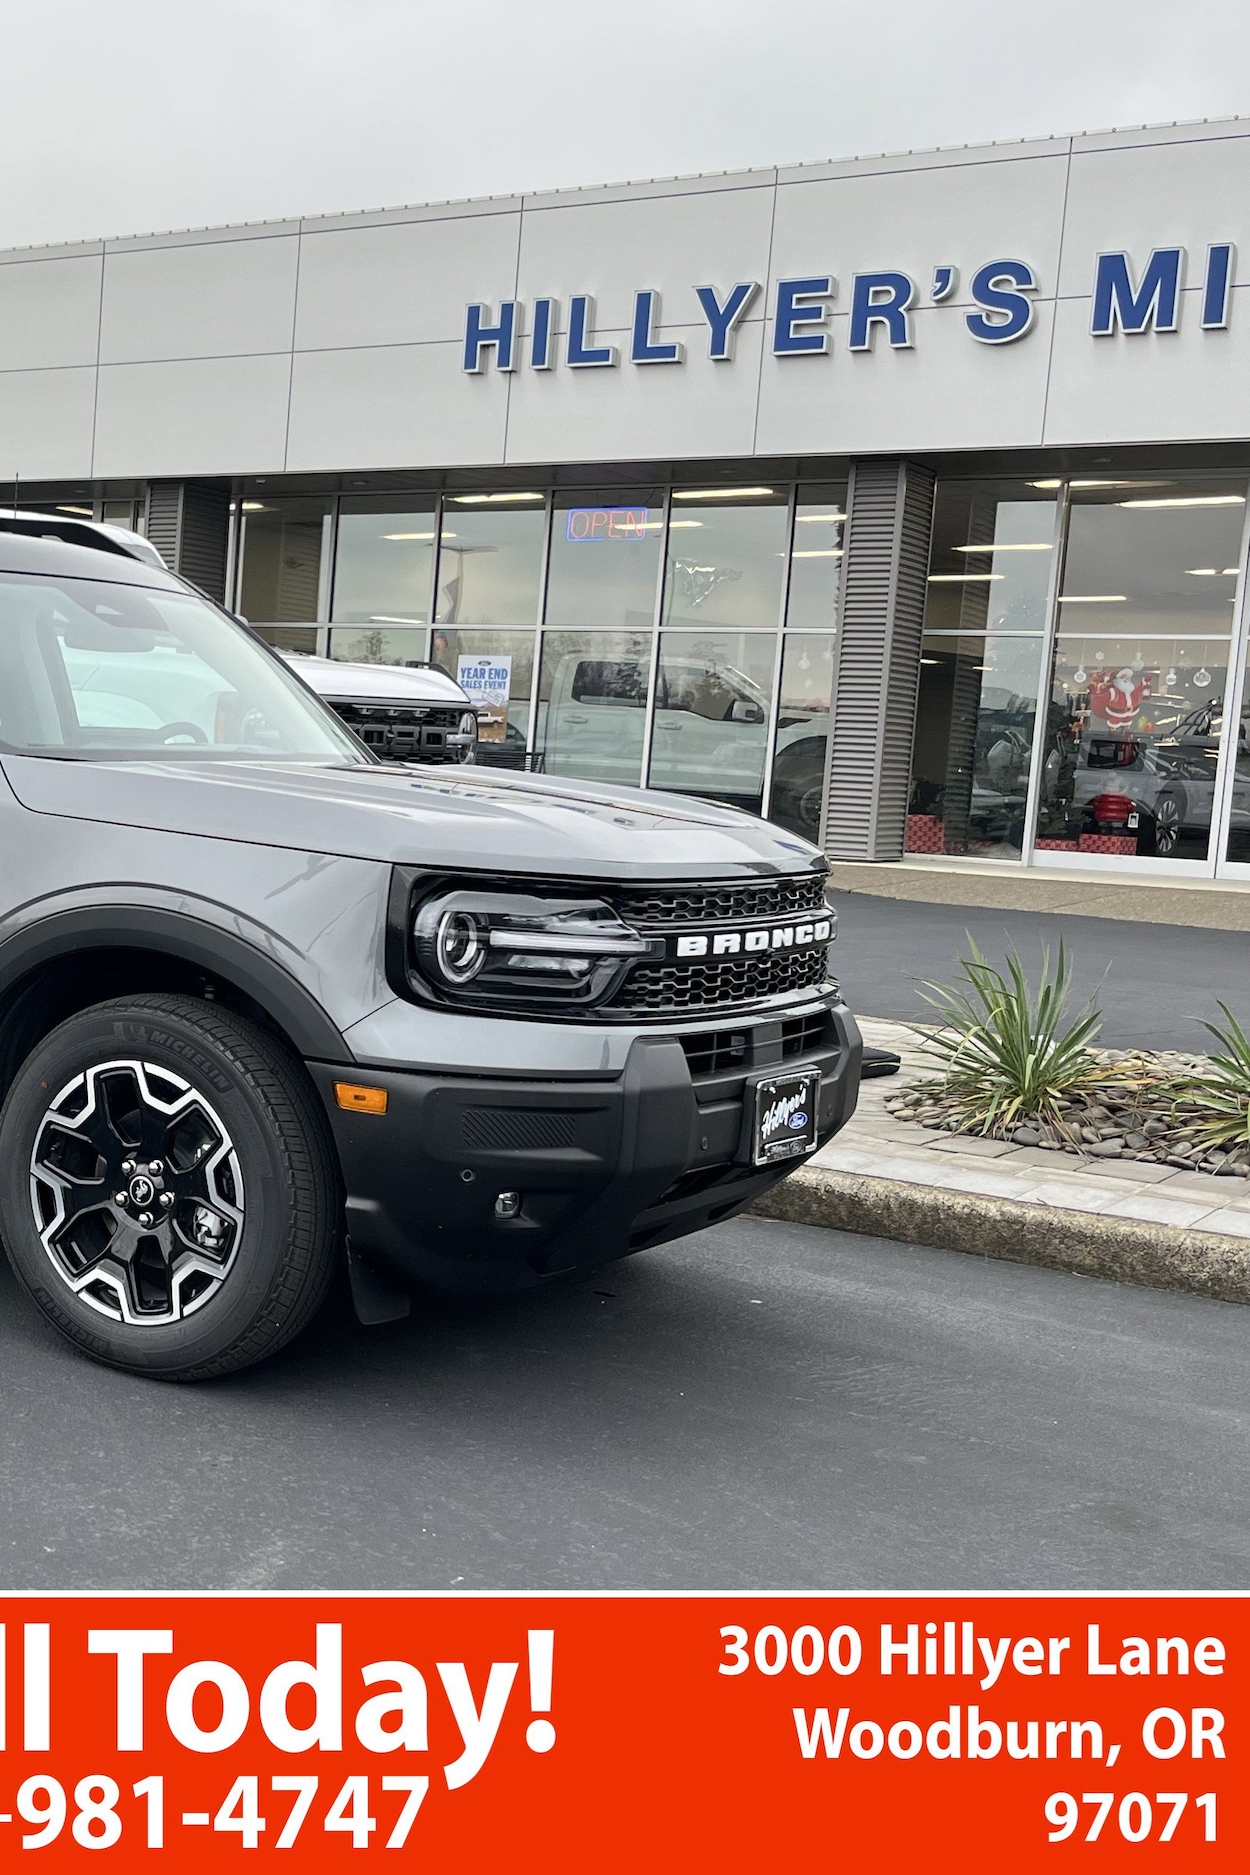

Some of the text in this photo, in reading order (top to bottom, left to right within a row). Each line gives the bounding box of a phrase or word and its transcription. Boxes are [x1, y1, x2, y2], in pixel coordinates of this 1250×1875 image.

[461, 242, 1235, 375] HILLYER'S MI
[569, 510, 646, 540] OPEN
[460, 667, 508, 681] YEAR END
[460, 680, 507, 691] SALES EVENT
[676, 920, 831, 957] BRONCO
[150, 1030, 230, 1091] MICHELIN
